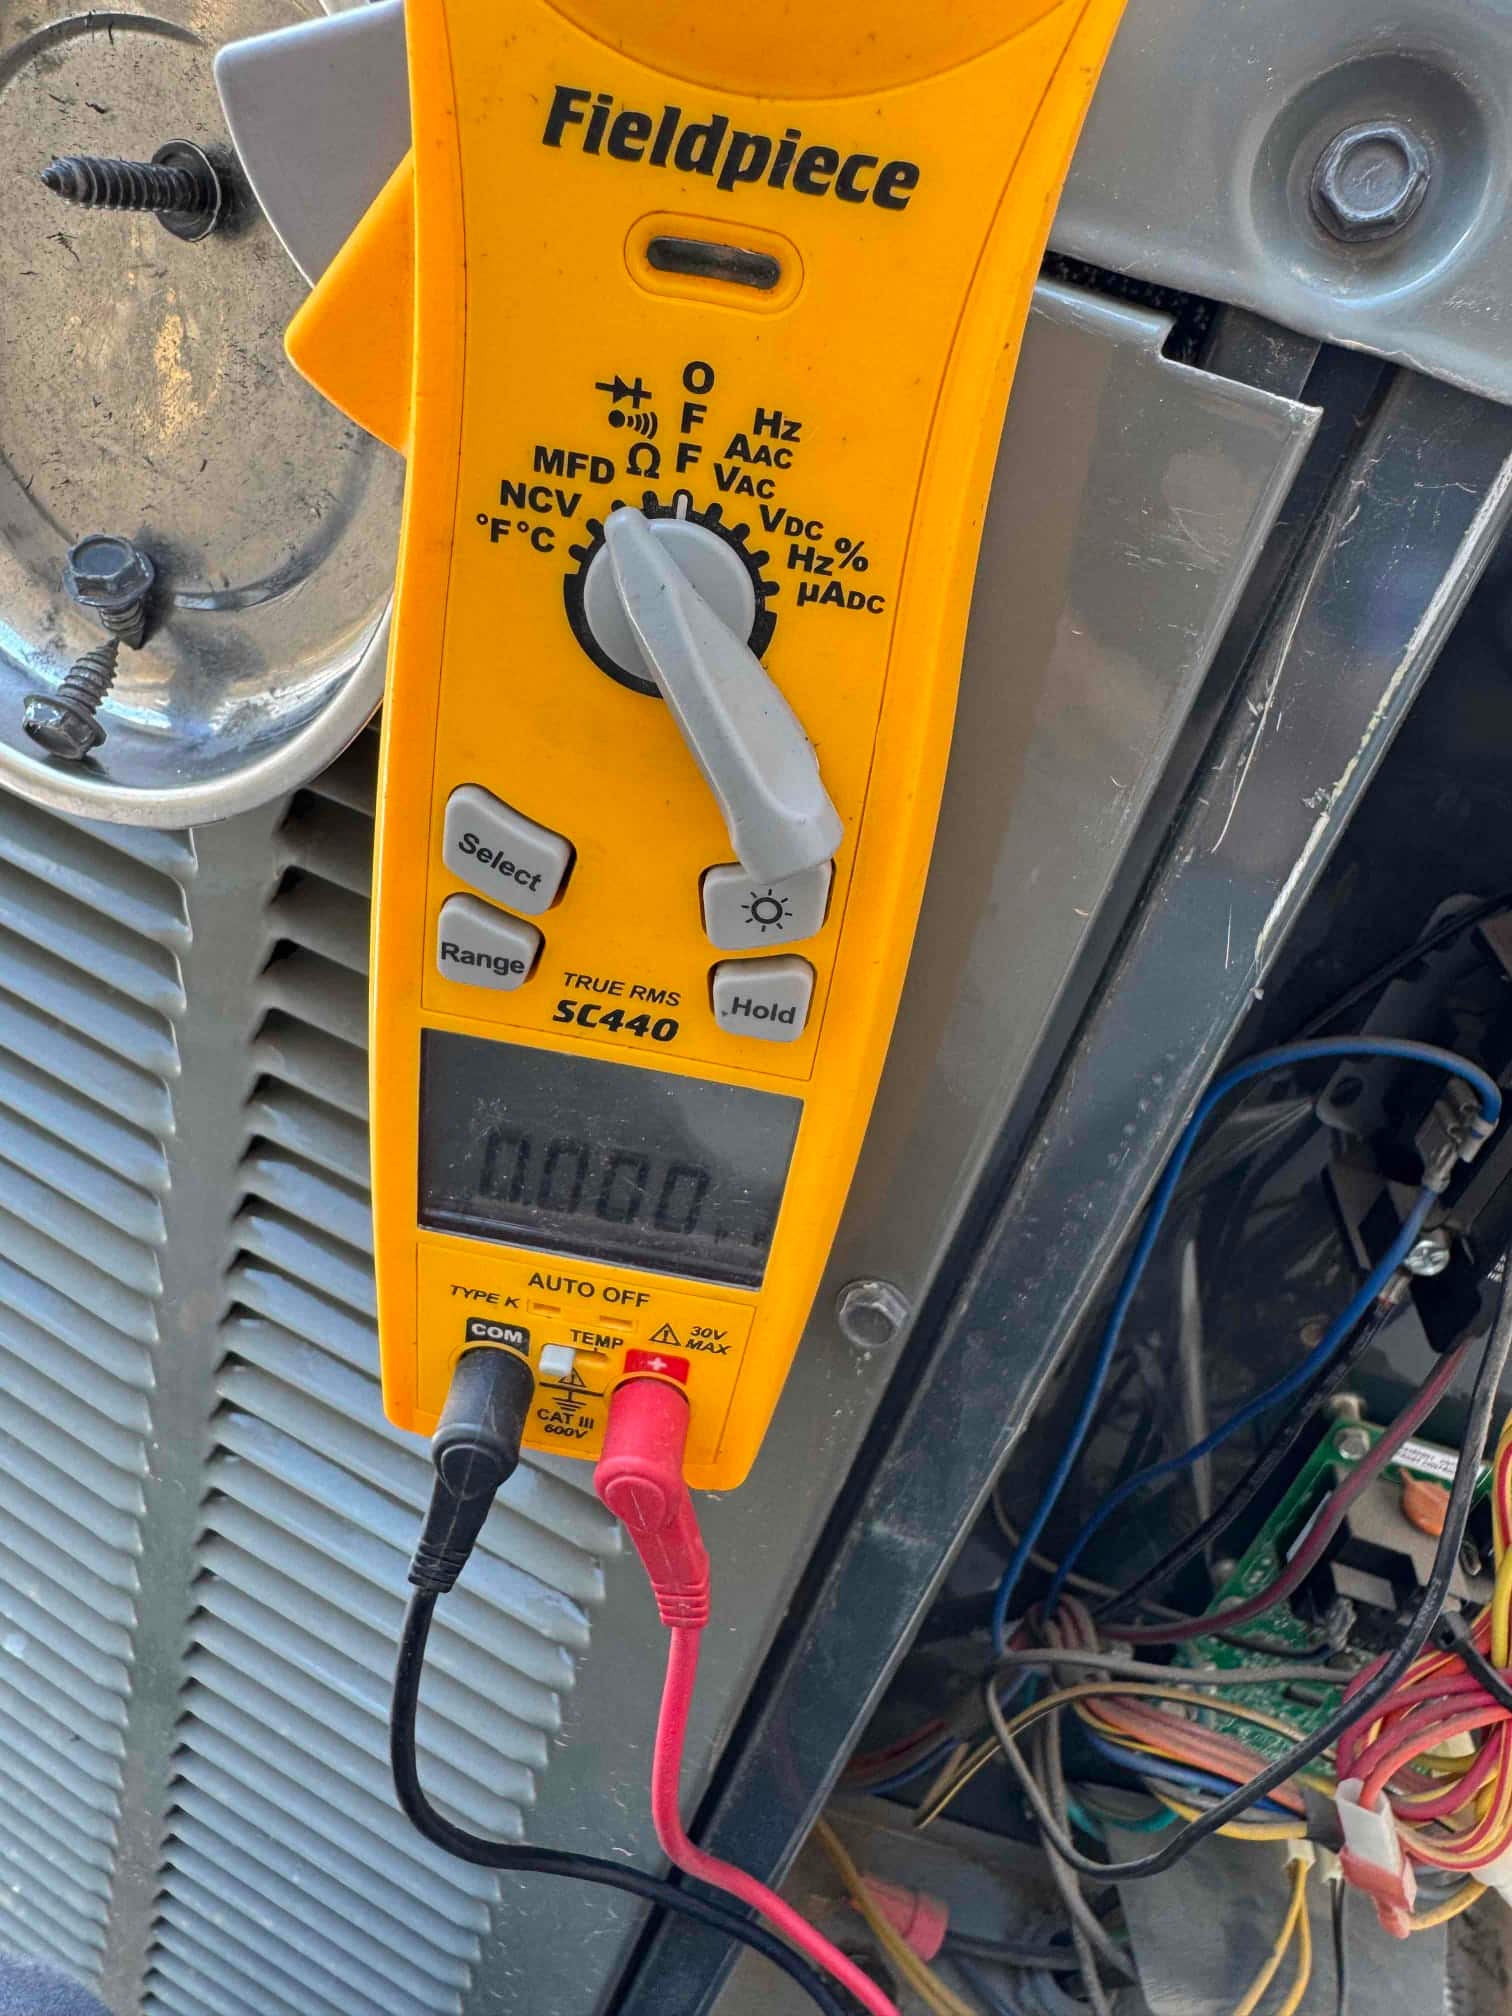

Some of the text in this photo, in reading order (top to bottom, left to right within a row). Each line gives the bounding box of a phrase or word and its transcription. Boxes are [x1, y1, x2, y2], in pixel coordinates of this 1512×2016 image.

[542, 85, 920, 210] Fieldpiece
[753, 408, 802, 442] Hz
[533, 446, 615, 484] MFD
[499, 480, 582, 518] NCV
[458, 833, 543, 892] Select
[440, 941, 525, 976] Range
[564, 972, 681, 1006] TRUE RMS
[552, 1000, 680, 1043] SC440
[731, 997, 797, 1025] Hold
[450, 1284, 520, 1309] TYPE K
[528, 1272, 650, 1308] AUTO OFF
[470, 1322, 523, 1345] COM
[570, 1329, 624, 1350] TEMP
[685, 1338, 732, 1356] MAX
[690, 1325, 728, 1341] 30V
[536, 1408, 595, 1429] CAT III
[543, 1423, 589, 1440] 600V
